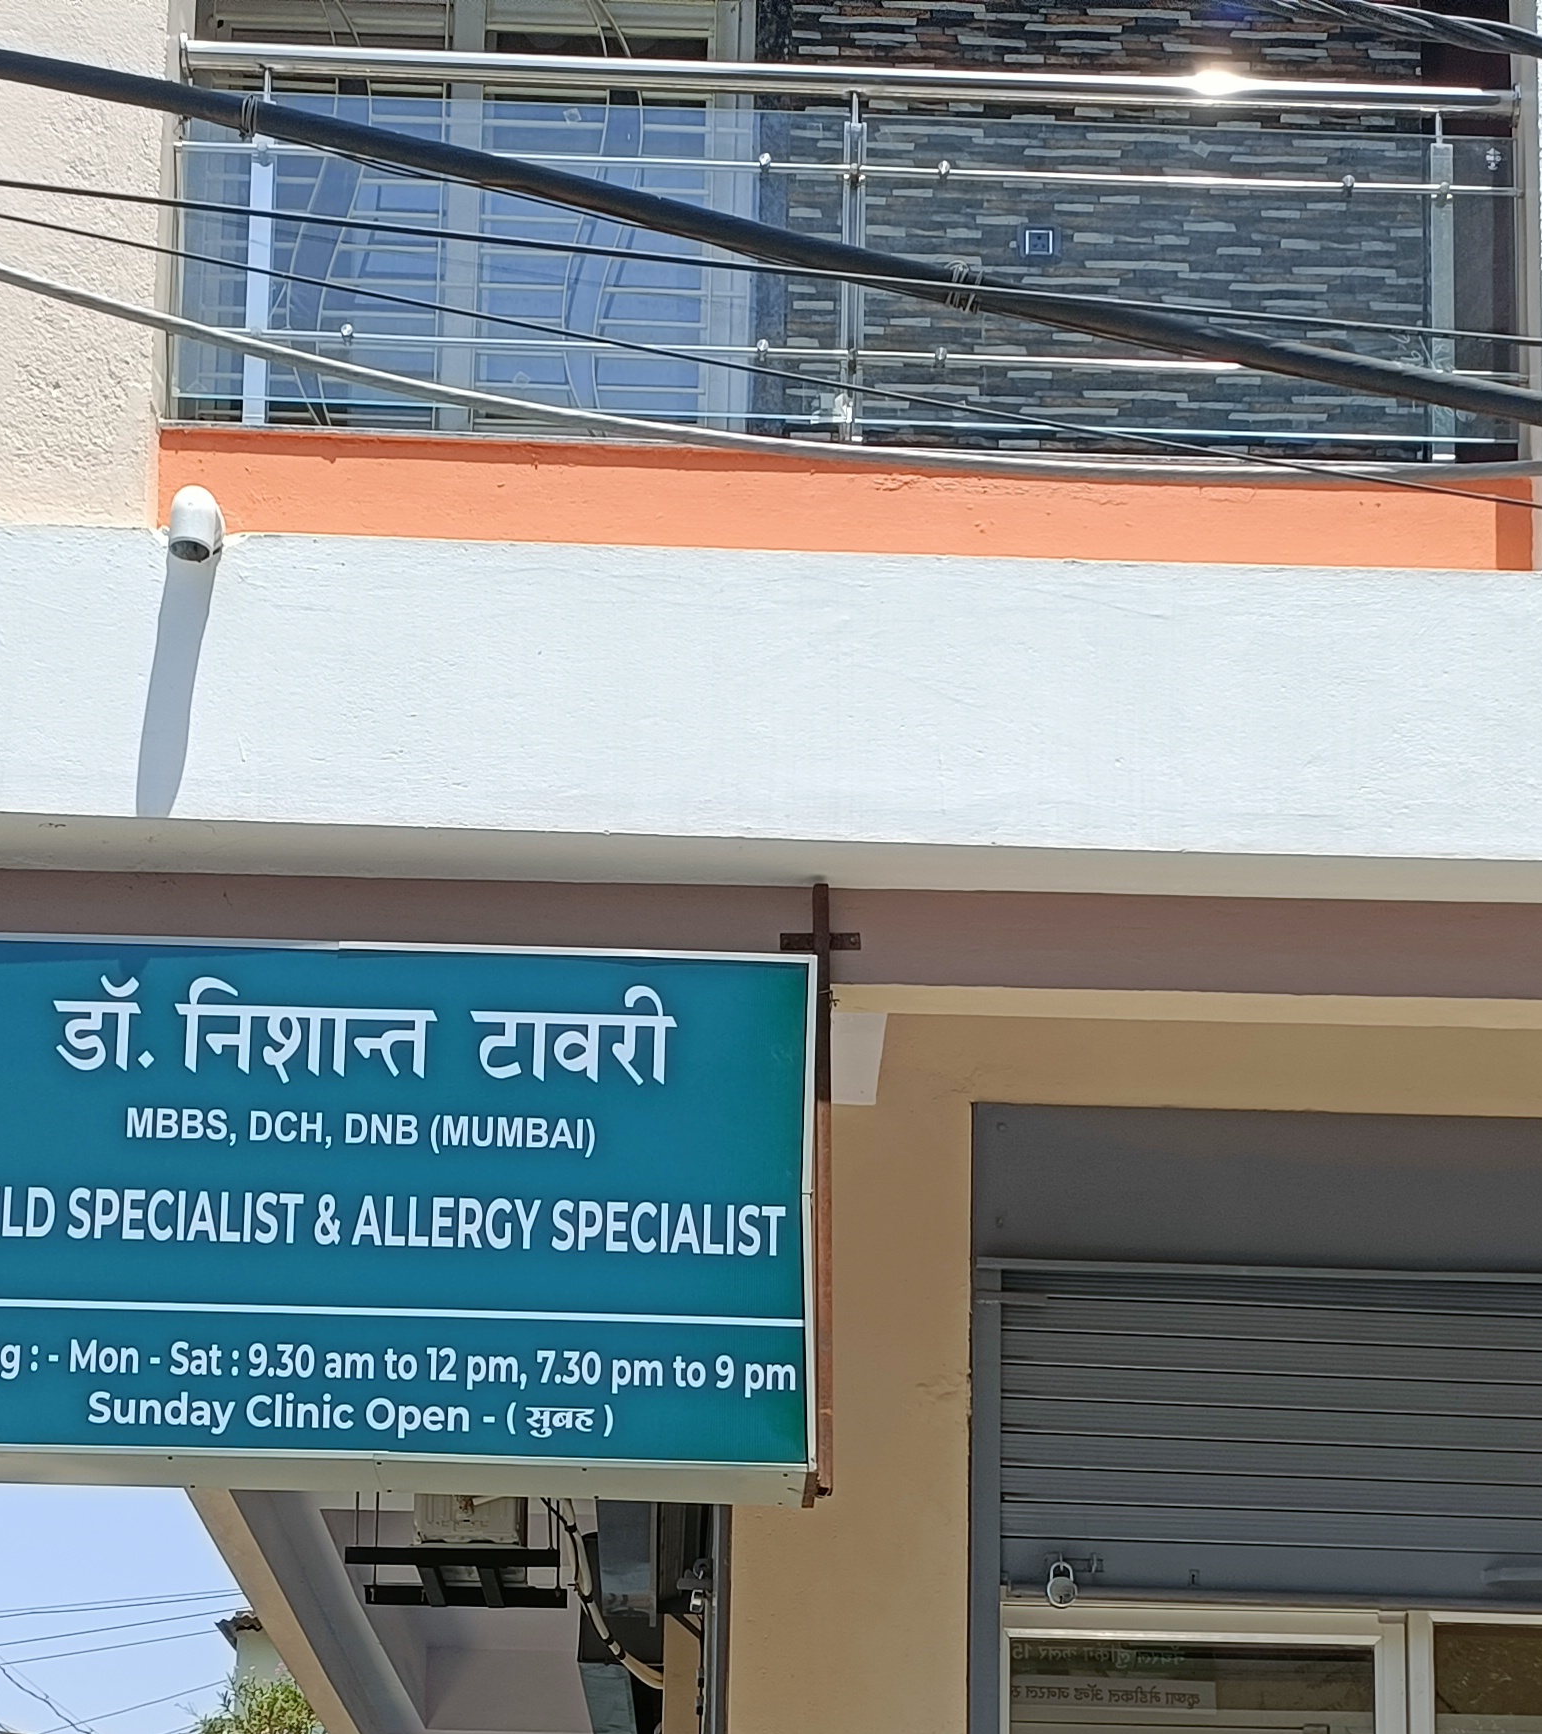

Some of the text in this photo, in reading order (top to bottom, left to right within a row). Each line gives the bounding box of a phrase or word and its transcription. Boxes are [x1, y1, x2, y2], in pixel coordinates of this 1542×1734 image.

[54, 976, 677, 1085] डॉ. निशान्त टावरी
[127, 1108, 595, 1157] MBBS, DCH, DNB (MUMBAI)
[68, 1188, 304, 1243] SPECIALIST
[315, 1194, 340, 1244] &
[352, 1196, 541, 1249] ALLERGY
[552, 1200, 786, 1255] SPECIALIST
[70, 1340, 138, 1373] Mon
[170, 1342, 221, 1375] Sat
[249, 1343, 314, 1377] 9.30
[325, 1353, 374, 1378] am
[385, 1349, 417, 1379] to
[427, 1348, 456, 1380] 12
[467, 1356, 526, 1389] pm,
[537, 1351, 601, 1384] 7.30
[612, 1360, 662, 1393] pm
[673, 1356, 705, 1387] to
[716, 1355, 734, 1388] 9
[745, 1364, 795, 1397] pm
[88, 1392, 235, 1434] Sunday
[247, 1393, 353, 1428] Clinic
[366, 1398, 469, 1438] Open
[526, 1408, 594, 1437] सुबह
